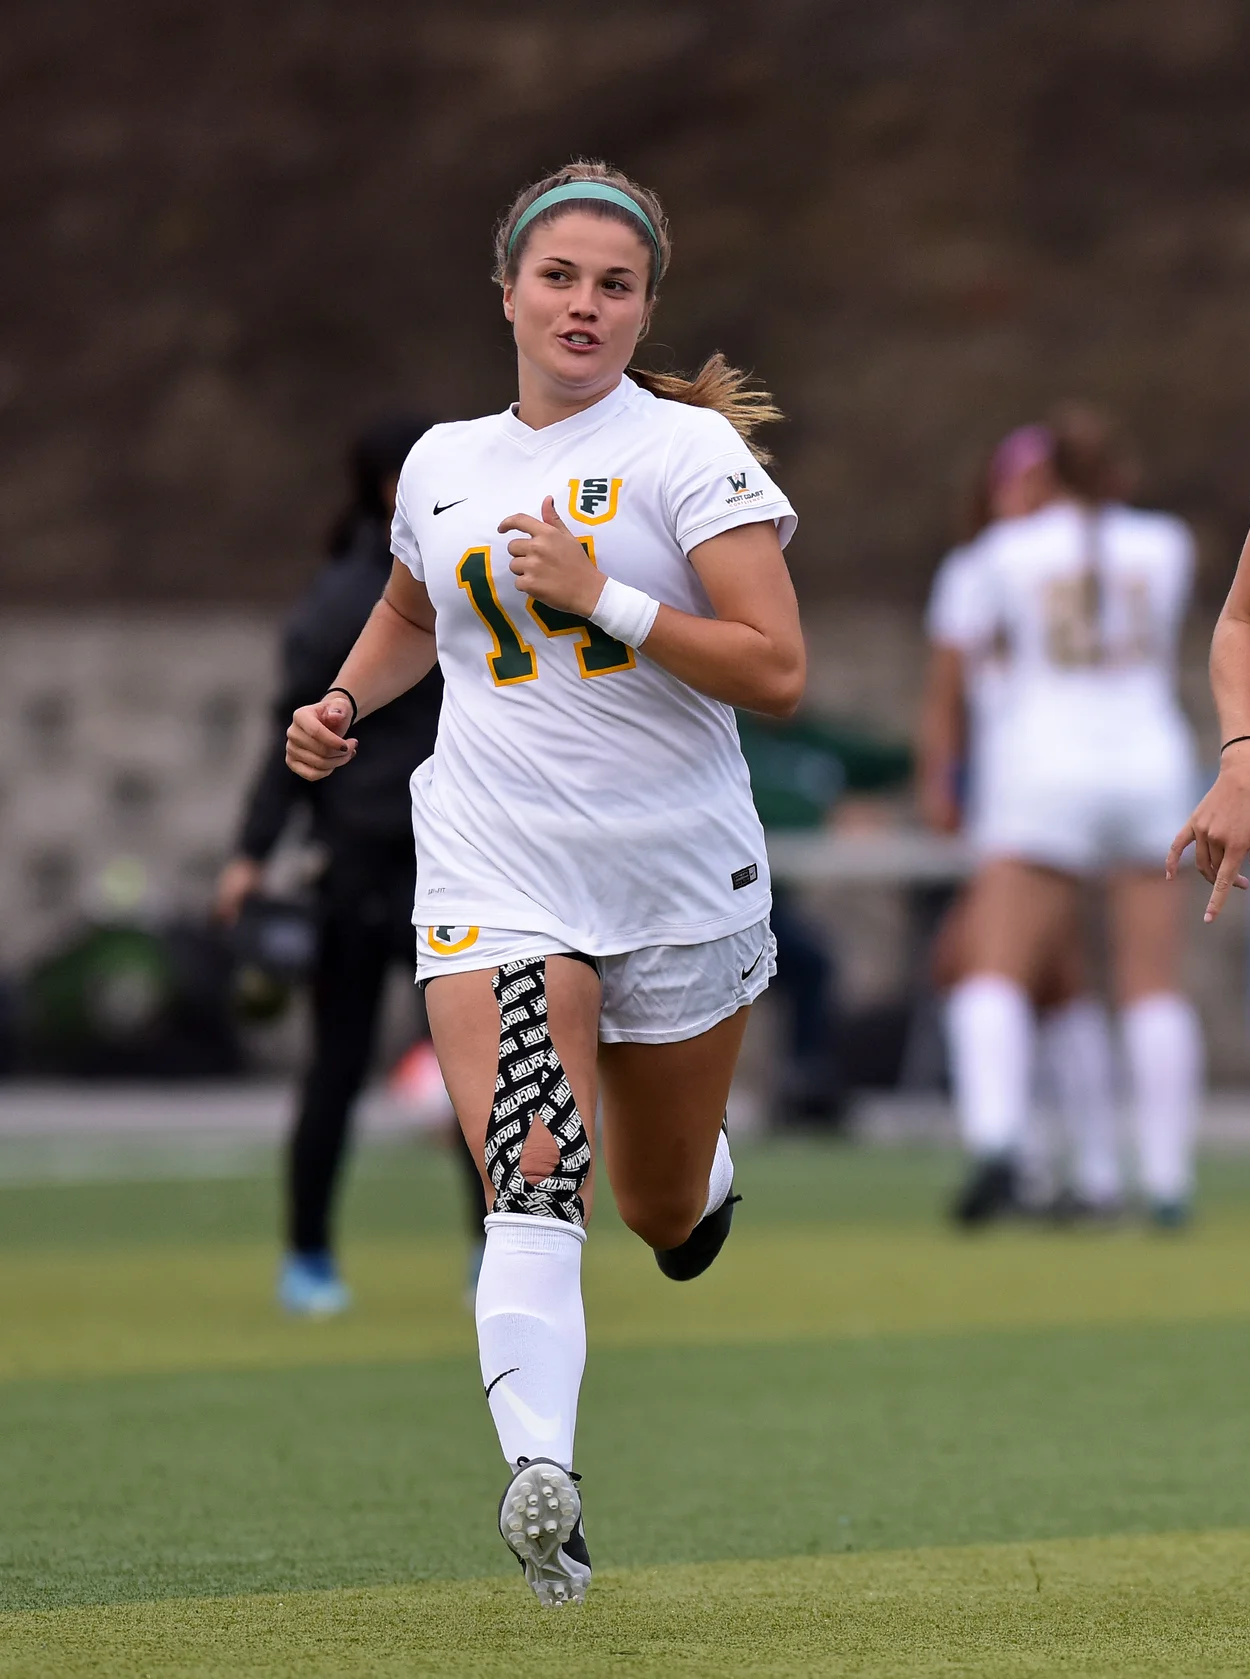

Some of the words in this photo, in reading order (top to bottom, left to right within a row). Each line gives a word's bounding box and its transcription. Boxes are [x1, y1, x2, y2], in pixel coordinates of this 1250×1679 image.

[725, 494, 744, 504] WEST
[743, 490, 764, 500] COAST
[493, 1083, 540, 1120] ROCKTAPE
